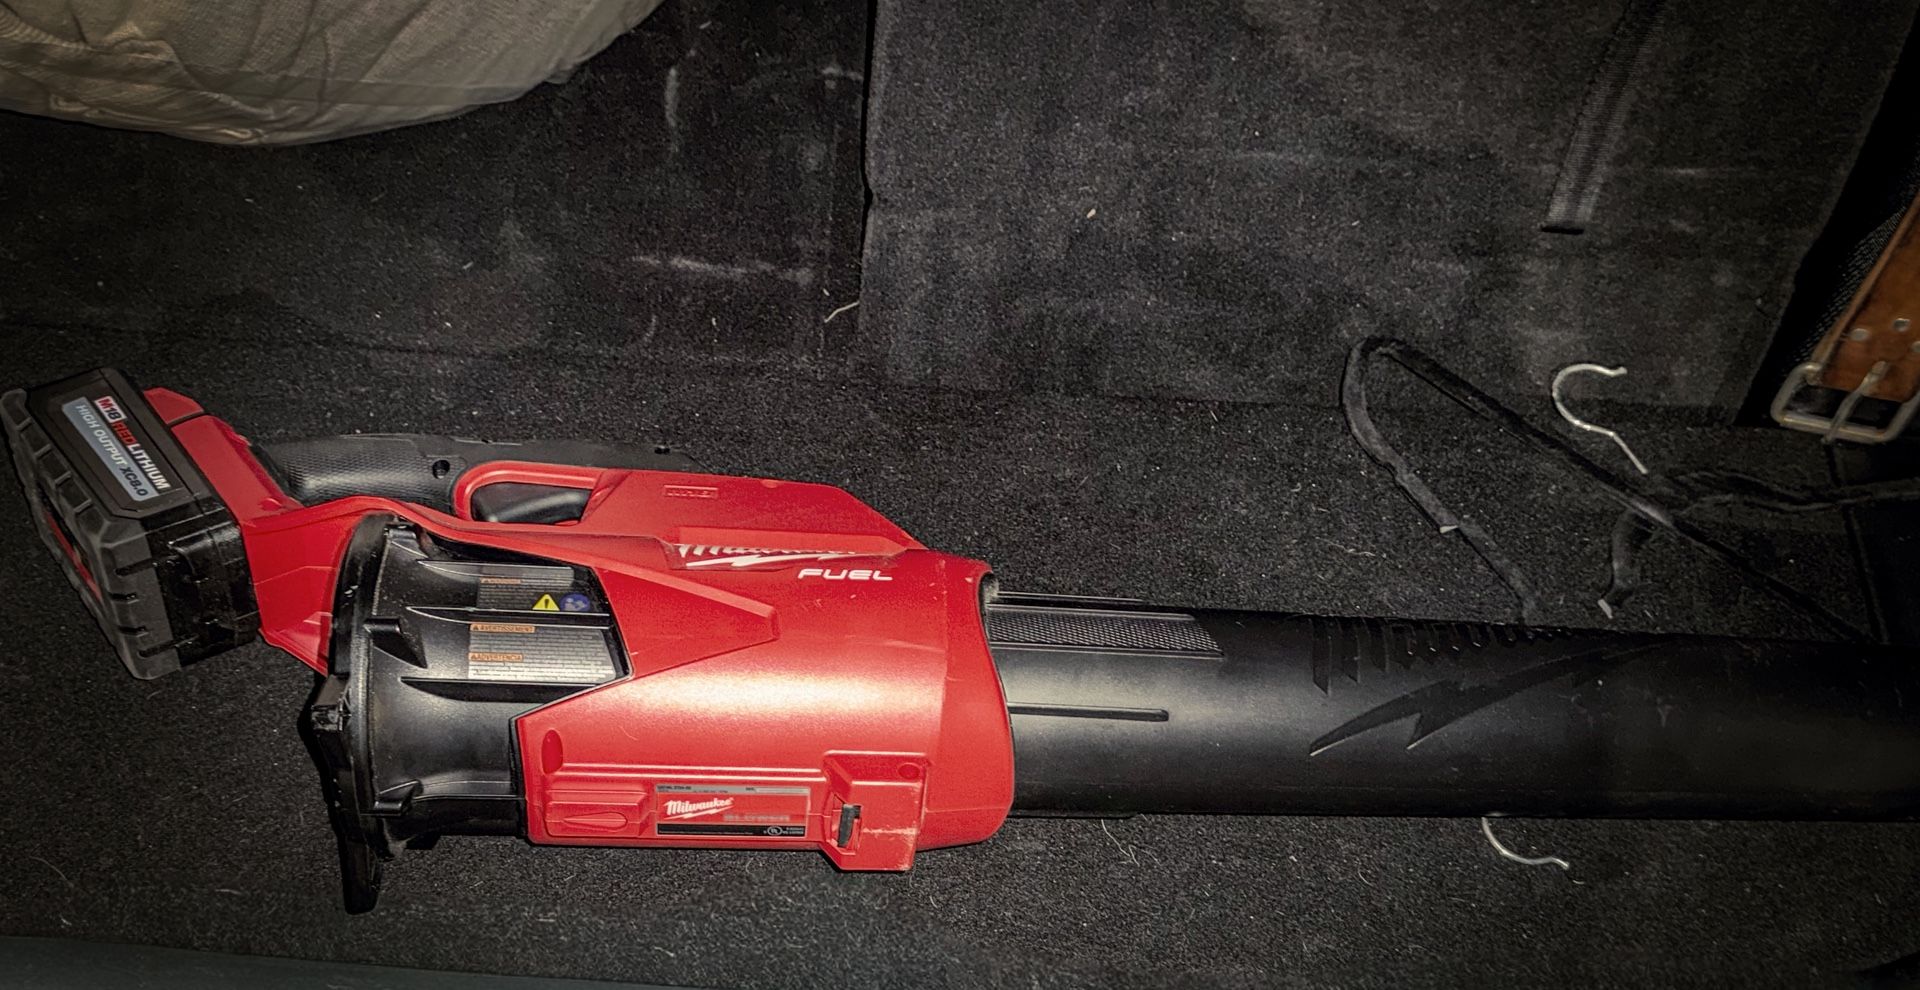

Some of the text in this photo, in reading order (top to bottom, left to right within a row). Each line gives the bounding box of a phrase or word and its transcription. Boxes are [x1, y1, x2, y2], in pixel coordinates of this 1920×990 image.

[98, 397, 122, 420] M18
[76, 405, 149, 496] HIGH OUTPUT XC8.0
[798, 569, 893, 581] FUEL
[663, 798, 734, 815] Milwaukee
